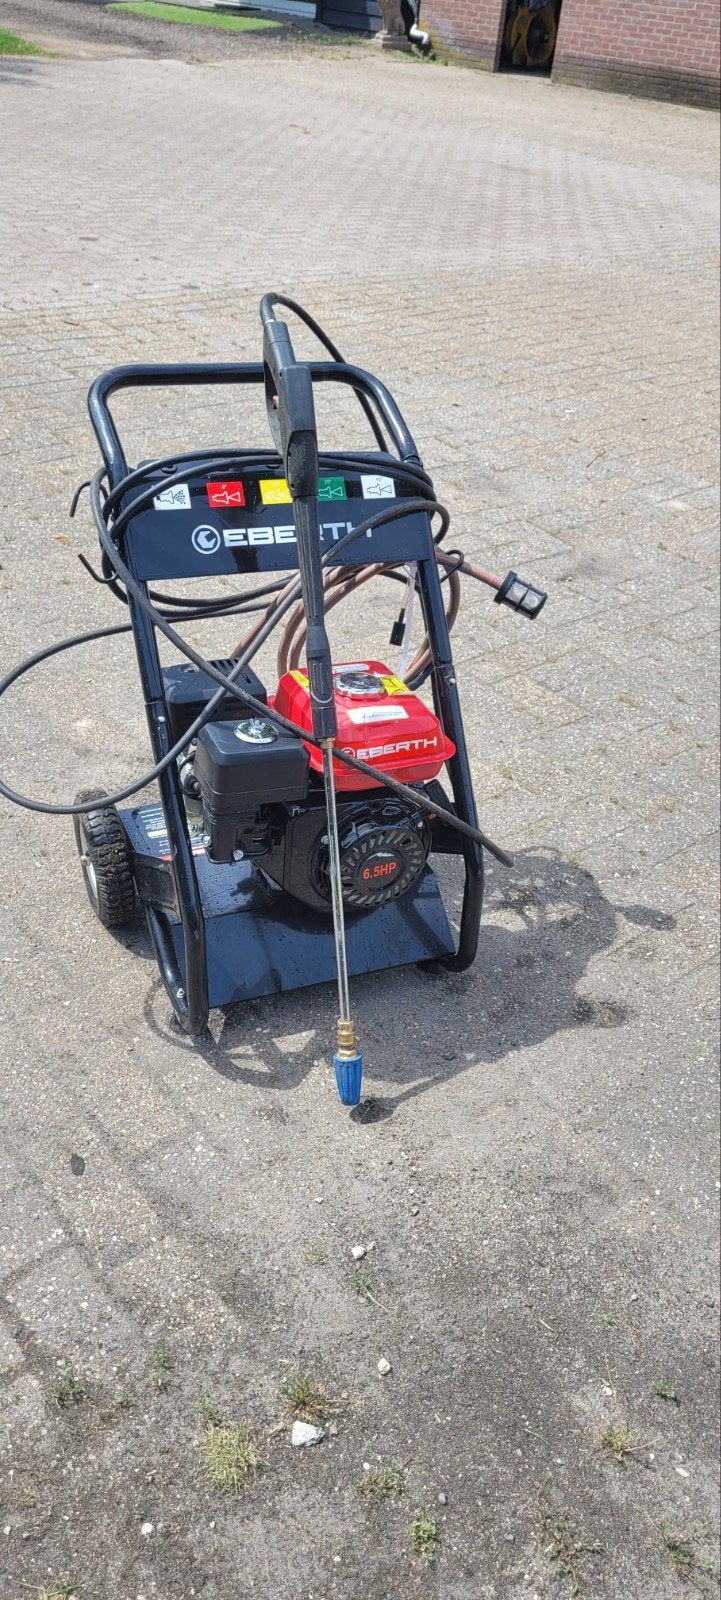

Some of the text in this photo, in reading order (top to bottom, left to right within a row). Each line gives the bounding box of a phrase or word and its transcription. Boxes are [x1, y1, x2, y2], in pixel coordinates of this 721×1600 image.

[222, 522, 373, 547] EBETH
[356, 736, 438, 760] EBERTH
[362, 862, 397, 880] 6.5HP
